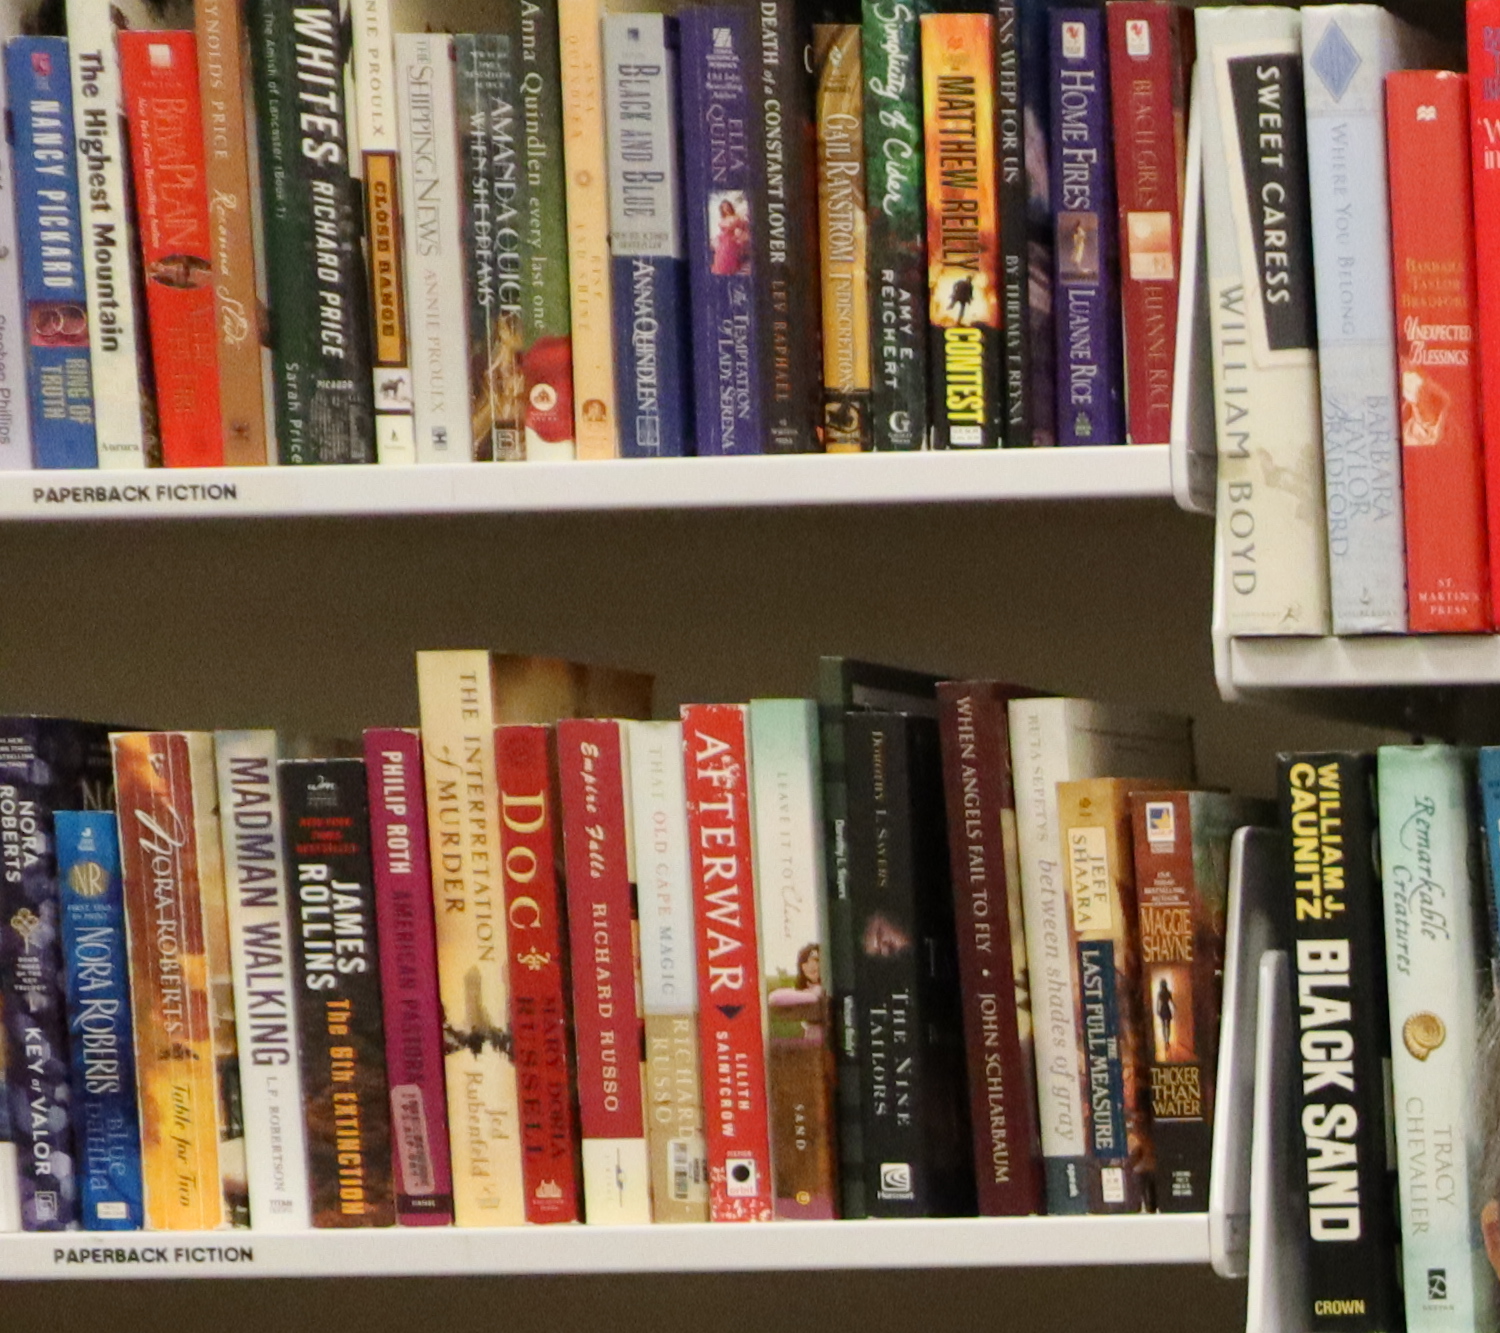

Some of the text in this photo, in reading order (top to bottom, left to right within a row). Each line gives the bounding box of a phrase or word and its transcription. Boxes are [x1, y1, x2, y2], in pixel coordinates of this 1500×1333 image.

[30, 99, 76, 289] NANCY PICKARD
[80, 51, 122, 352] The Highest Mountain
[938, 76, 980, 272] MATTHEW REILLY
[1255, 66, 1291, 304] SWEET CARESS
[944, 327, 985, 426] CONTEST
[1219, 284, 1258, 597] WILLIAM BOYD
[32, 483, 238, 504] PAPERBACK FICTION
[380, 751, 411, 874] PHILIP ROTH
[500, 789, 550, 930] DOC
[692, 728, 744, 994] AFTERWAR
[1290, 762, 1324, 920] CAUNITZ
[1322, 762, 1346, 921] WILLIAM J.
[229, 757, 292, 1067] MADMAN WALKING
[1296, 939, 1361, 1241] BLACK SAND
[54, 1246, 253, 1264] PAPERBACK FICTION
[1314, 1300, 1364, 1315] CROWN
